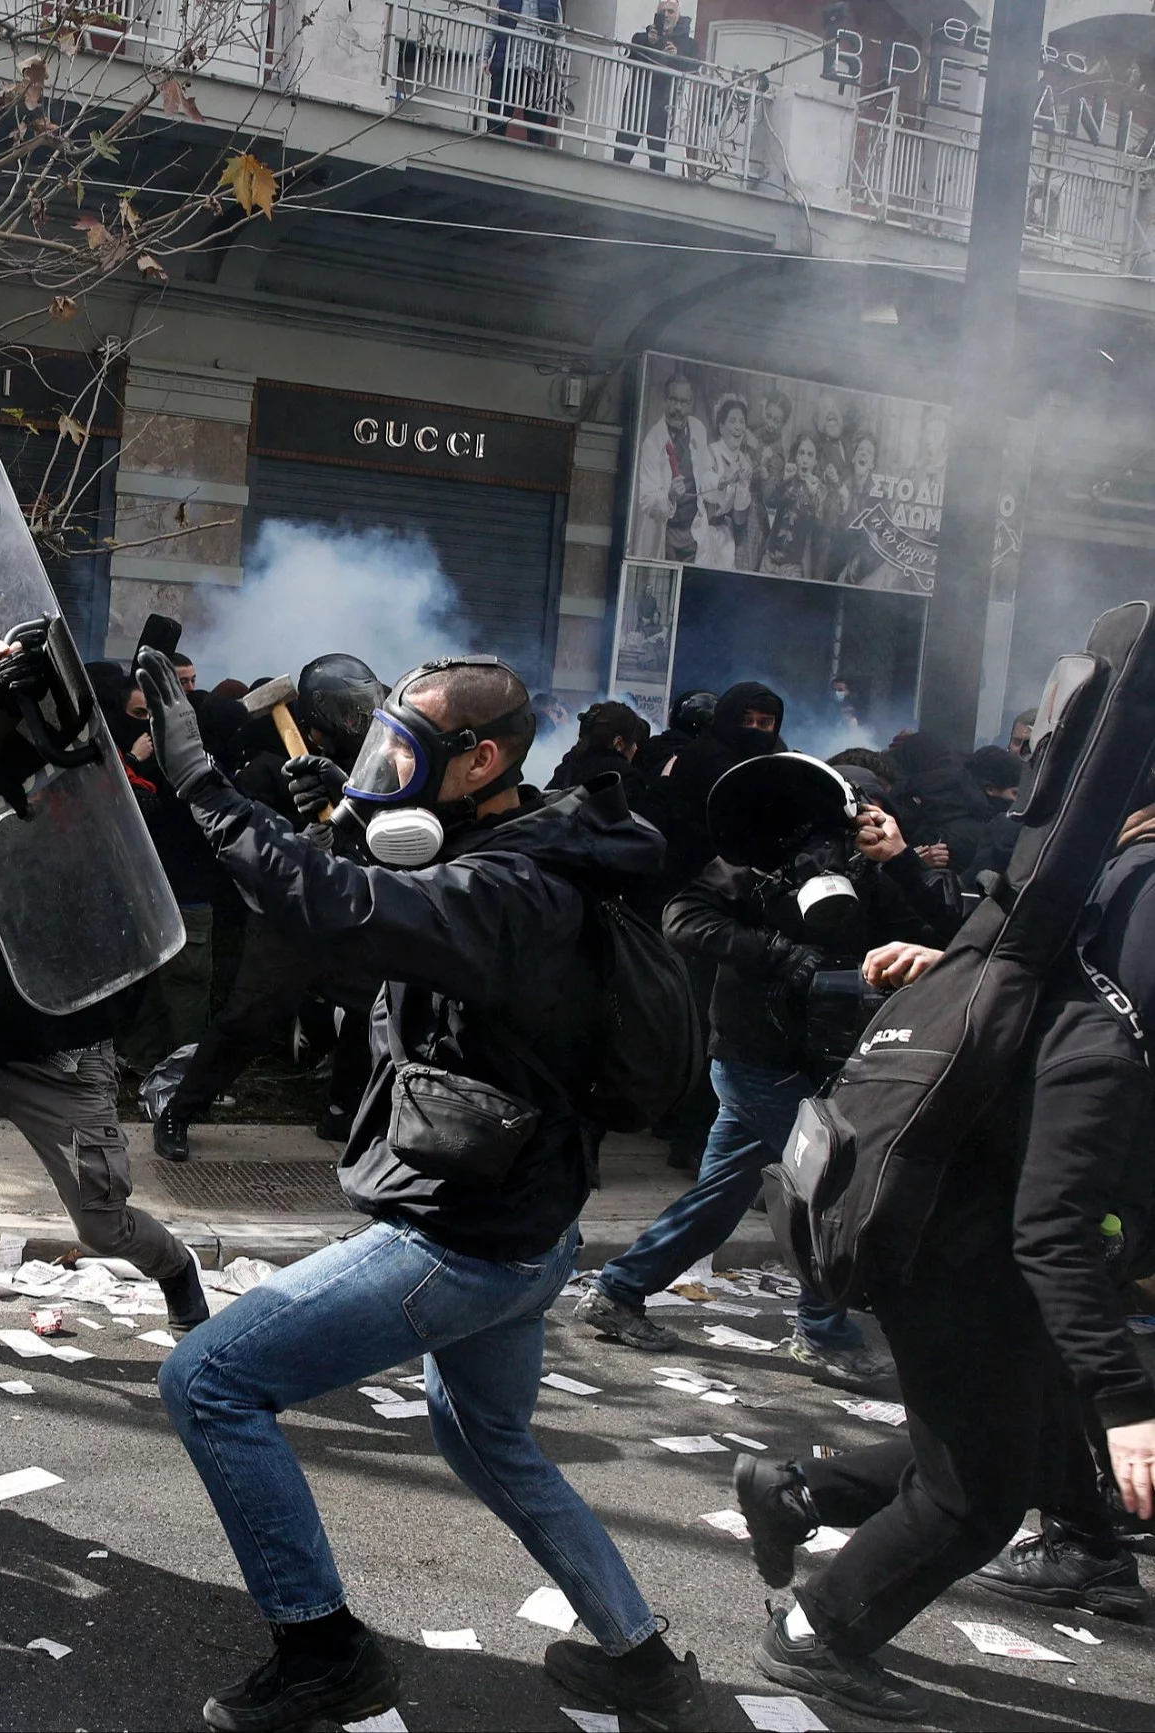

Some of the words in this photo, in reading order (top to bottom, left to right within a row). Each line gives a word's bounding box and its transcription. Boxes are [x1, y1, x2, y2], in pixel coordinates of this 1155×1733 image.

[835, 28, 1155, 160] ΒΡΕΑΝΙ
[353, 418, 486, 459] GUCCI
[870, 473, 914, 502] ΣΤΟ
